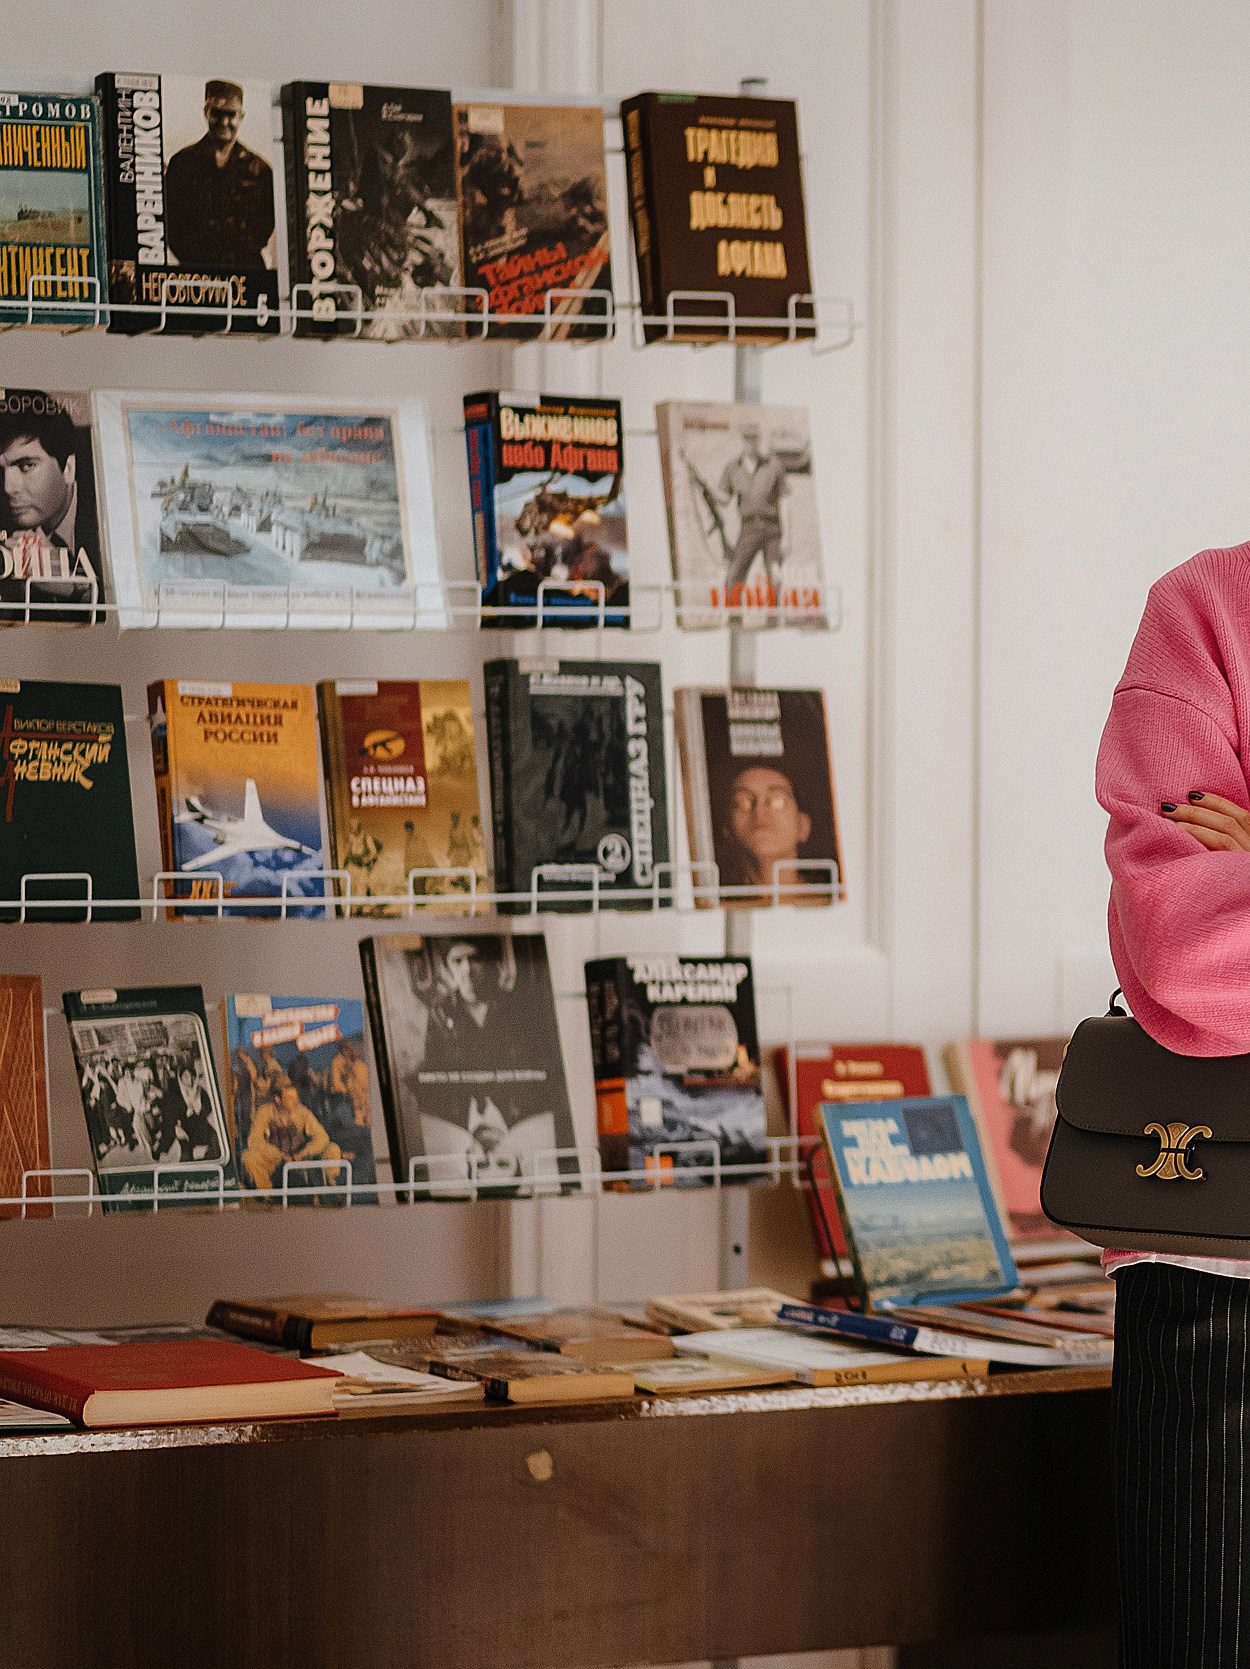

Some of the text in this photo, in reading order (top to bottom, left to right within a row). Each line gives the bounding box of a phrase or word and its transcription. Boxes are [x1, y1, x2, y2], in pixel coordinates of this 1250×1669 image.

[0, 101, 91, 120] ТРОМОВ
[0, 122, 87, 169] НИЧЕННЫЙ
[118, 89, 135, 184] ВАЛЕНТИН
[132, 90, 166, 266] ВАРЕННИКОВ
[13, 718, 55, 732] ВИКТОР
[203, 728, 279, 745] РОССИИ
[350, 775, 426, 795] СПЕЦНАЗ
